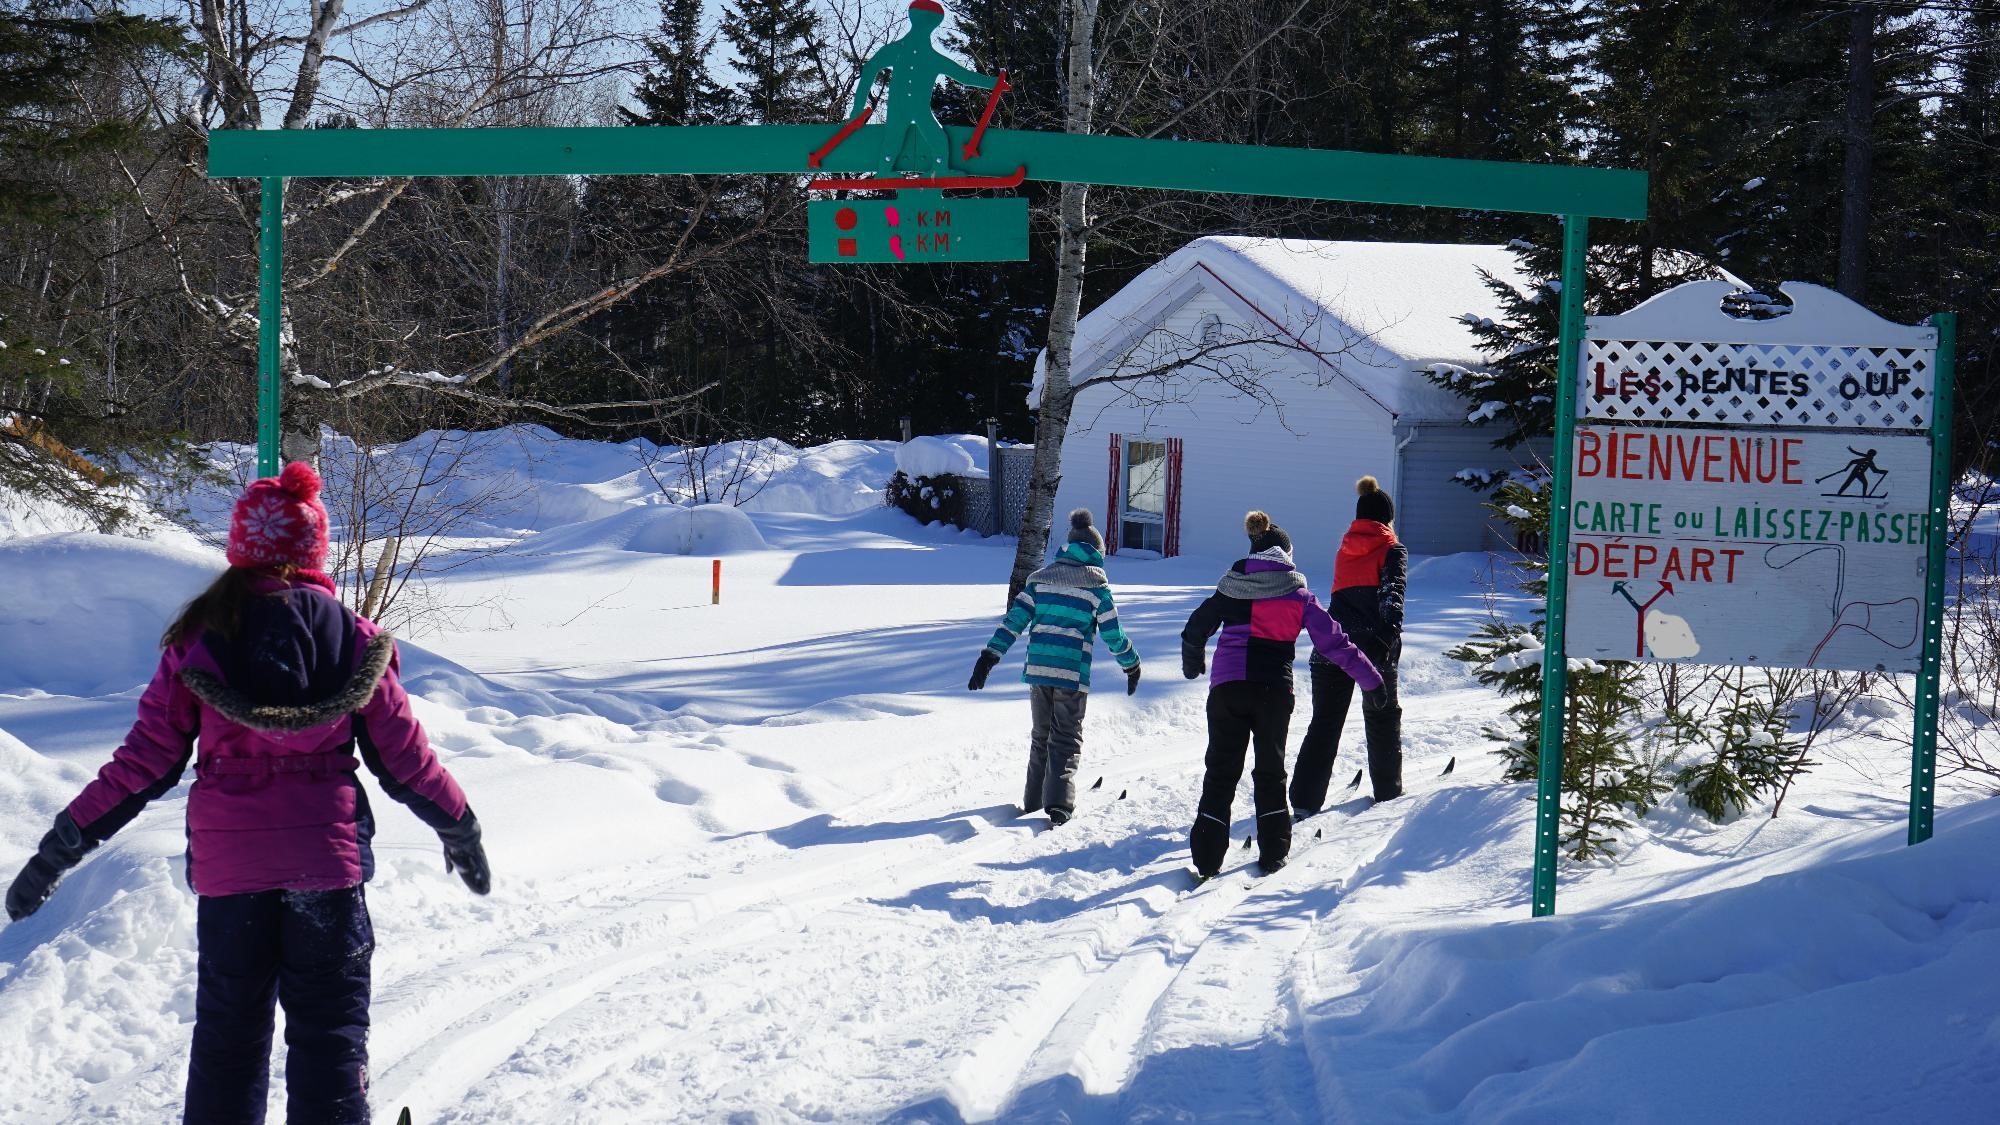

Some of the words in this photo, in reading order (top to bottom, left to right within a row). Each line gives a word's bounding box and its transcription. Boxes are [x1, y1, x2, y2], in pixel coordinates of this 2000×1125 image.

[1595, 362, 1661, 397] LES
[1680, 367, 1809, 397] PENTES
[1839, 368, 1911, 400] OUF
[1578, 430, 1804, 484] BIENVENUE
[1574, 501, 1662, 534] CARTE
[1574, 537, 1744, 583] DÉPART
